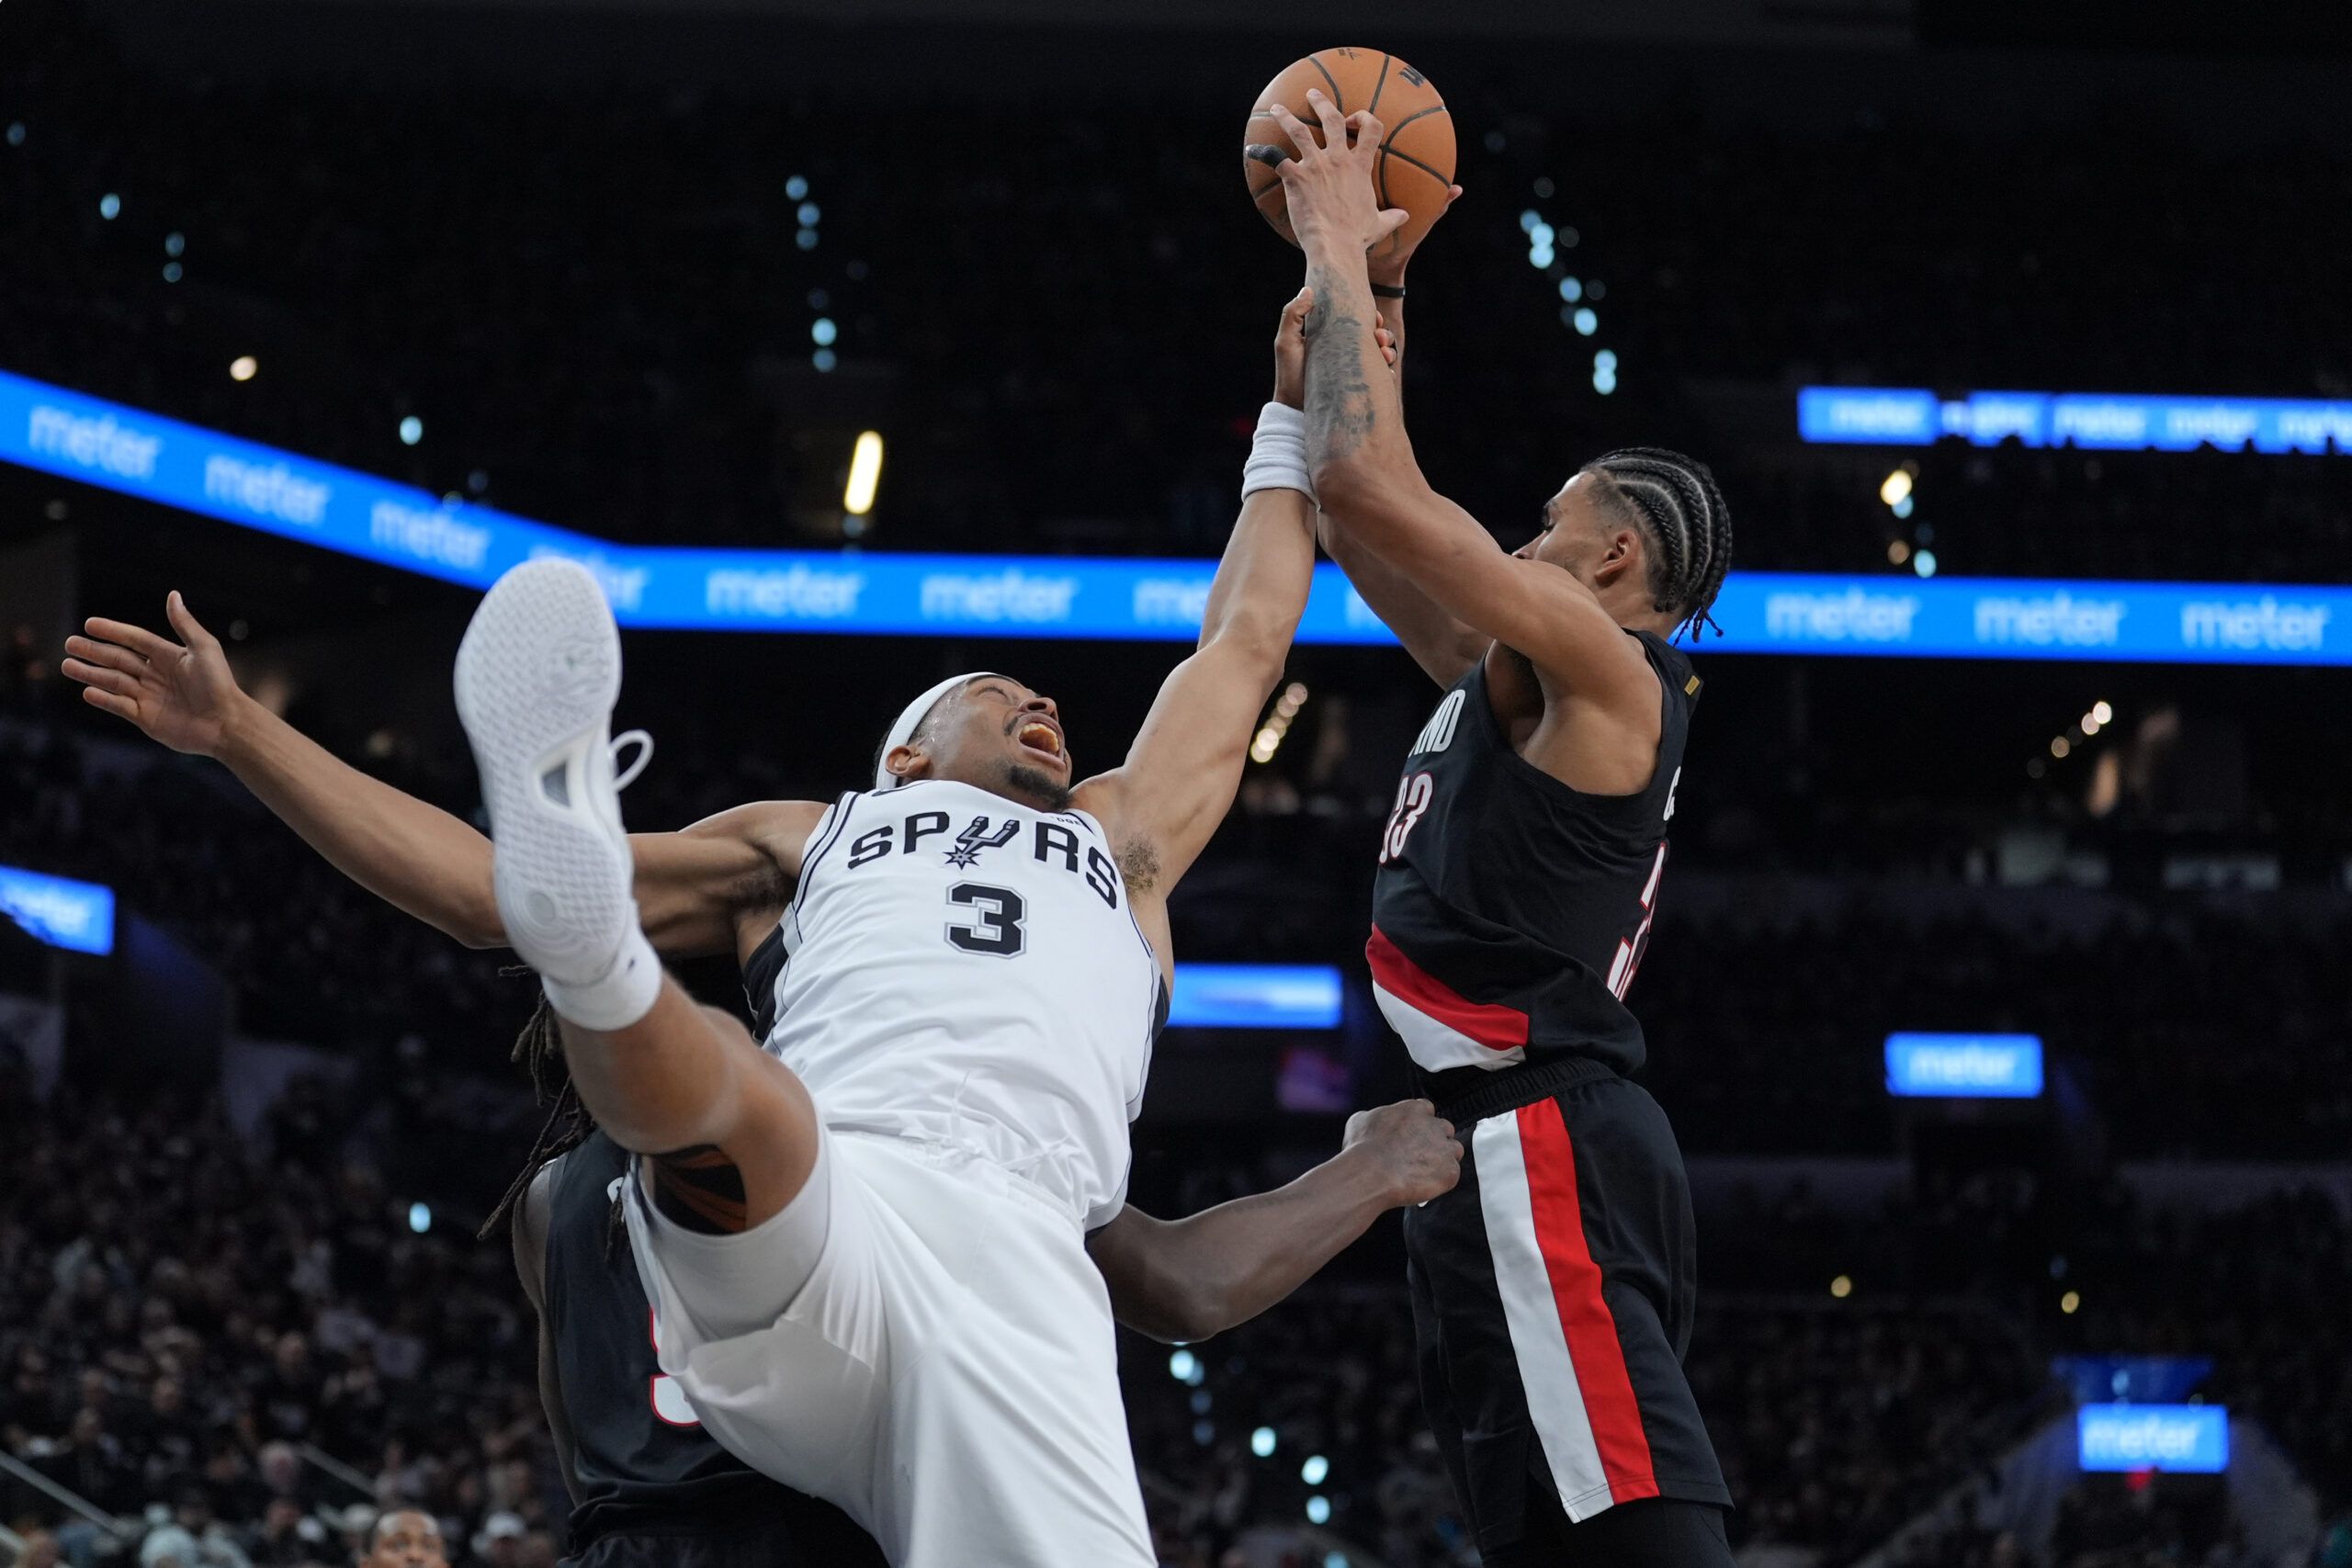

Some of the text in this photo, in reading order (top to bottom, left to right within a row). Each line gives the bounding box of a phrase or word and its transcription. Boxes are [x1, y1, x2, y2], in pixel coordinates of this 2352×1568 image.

[28, 405, 492, 571] meter meter meter
[706, 563, 867, 618] meter
[922, 566, 1079, 622] meter
[1765, 584, 2331, 651] meter meter meter
[847, 811, 1117, 910] SPURS
[944, 879, 1028, 960] 3
